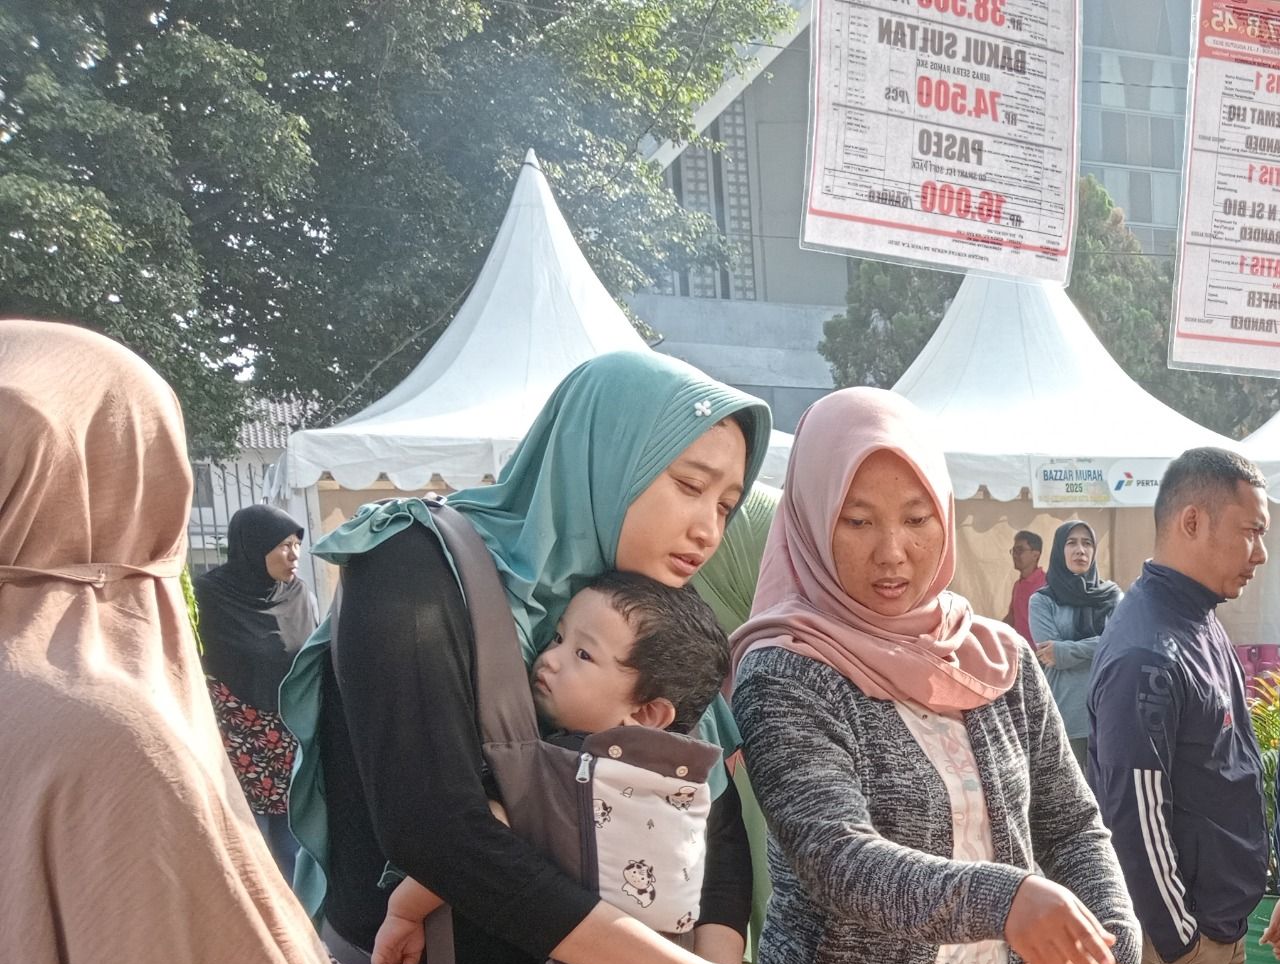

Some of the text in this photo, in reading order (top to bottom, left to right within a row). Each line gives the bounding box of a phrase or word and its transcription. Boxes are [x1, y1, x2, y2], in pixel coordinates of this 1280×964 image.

[1043, 469, 1103, 481] BAZZAR MURAH
[1065, 483, 1083, 493] 2025
[1136, 479, 1159, 487] PERTA
